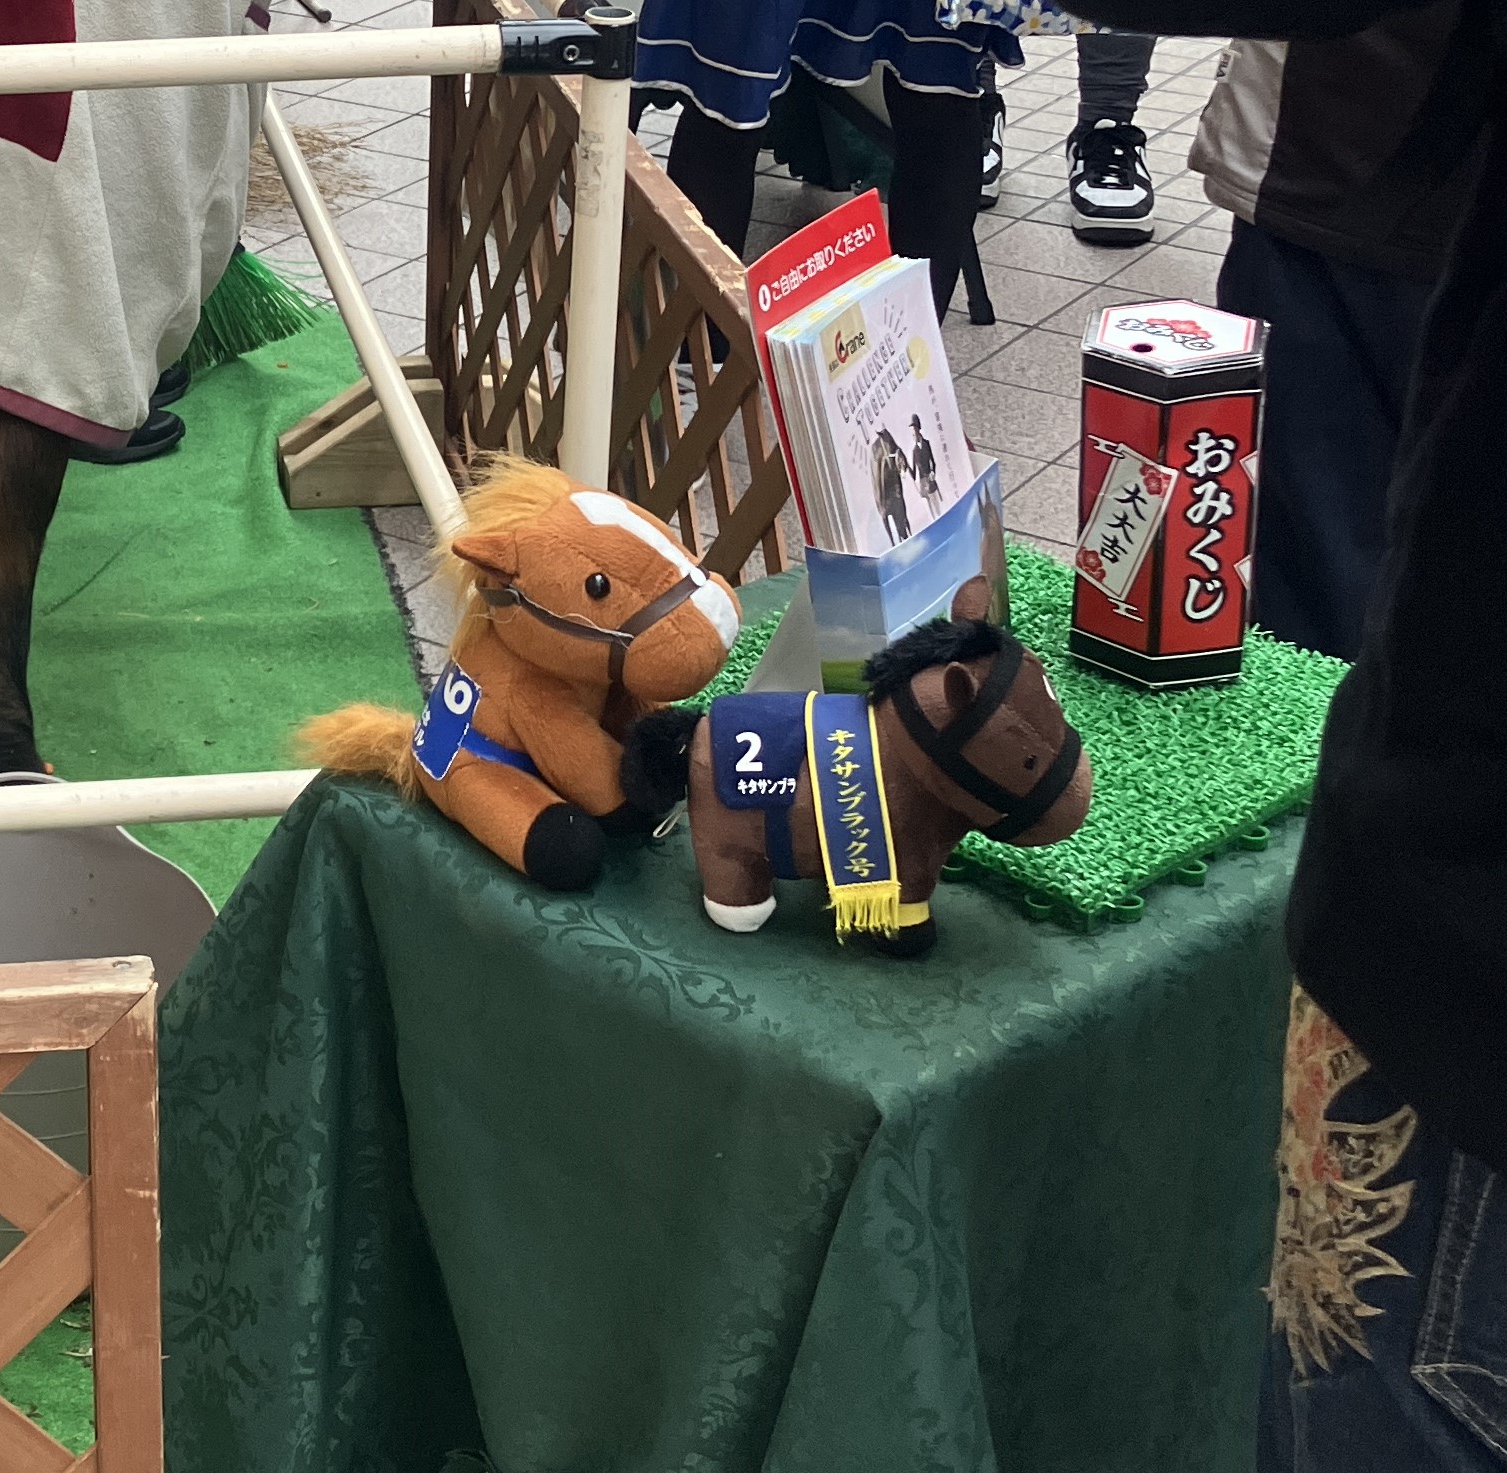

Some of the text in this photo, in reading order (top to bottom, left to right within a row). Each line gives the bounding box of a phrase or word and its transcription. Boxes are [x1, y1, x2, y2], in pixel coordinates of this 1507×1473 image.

[771, 223, 876, 302] ご自由にお取りください
[835, 330, 866, 364] Crane
[1115, 318, 1215, 351] おみくじ
[837, 332, 895, 424] CHALLENGE
[1099, 481, 1148, 565] 大大吉
[1182, 431, 1237, 621] おみくじ
[443, 672, 473, 715] 6
[734, 730, 764, 772] 2
[737, 777, 797, 795] キタサンブラ
[826, 729, 876, 878] キタサンブラック号
